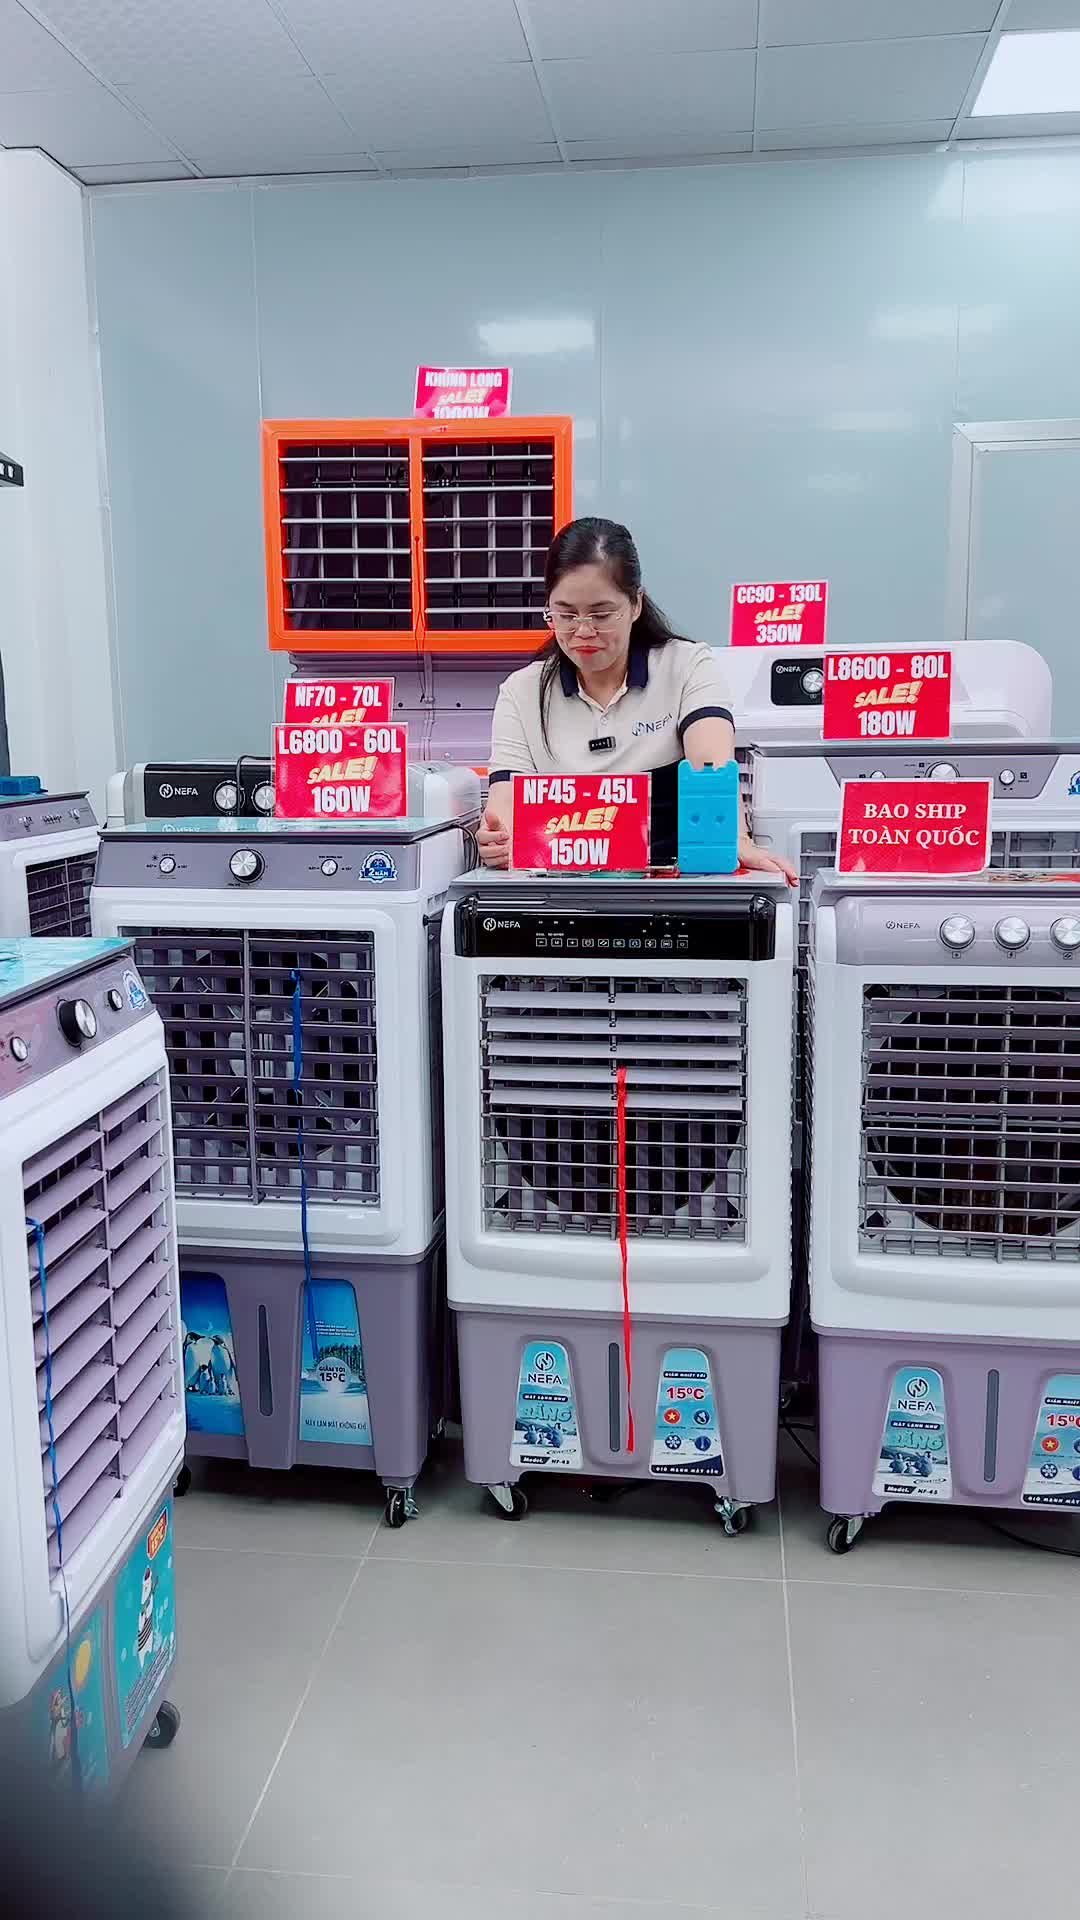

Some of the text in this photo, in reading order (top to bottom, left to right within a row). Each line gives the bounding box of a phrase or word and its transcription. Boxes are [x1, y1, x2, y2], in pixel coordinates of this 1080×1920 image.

[470, 372, 503, 387] LONG
[737, 585, 775, 604] CC90
[788, 584, 823, 602] 130L
[754, 603, 806, 624] SALE!
[756, 624, 803, 644] 350W
[828, 656, 890, 681] L8600
[911, 655, 949, 680] 80L
[295, 686, 336, 707] NF70
[352, 685, 382, 707] 70L
[853, 681, 924, 709] SALE!
[857, 710, 916, 736] 180W
[279, 728, 343, 755] L6800
[363, 728, 402, 754] 60L
[306, 756, 379, 785] SALE!
[174, 787, 199, 796] NEFA
[311, 785, 371, 813] 160W
[523, 778, 576, 804] NF45
[597, 778, 638, 804] 45L
[544, 805, 619, 835] SALE!
[863, 803, 967, 819] BAO SHIP
[848, 824, 980, 849] TOÀN QUỐC
[549, 838, 610, 866] 150W
[320, 1372, 346, 1383] 15°C
[527, 1373, 562, 1385] NEFA
[667, 1387, 705, 1400] 15°C
[898, 1400, 936, 1412] NEFA
